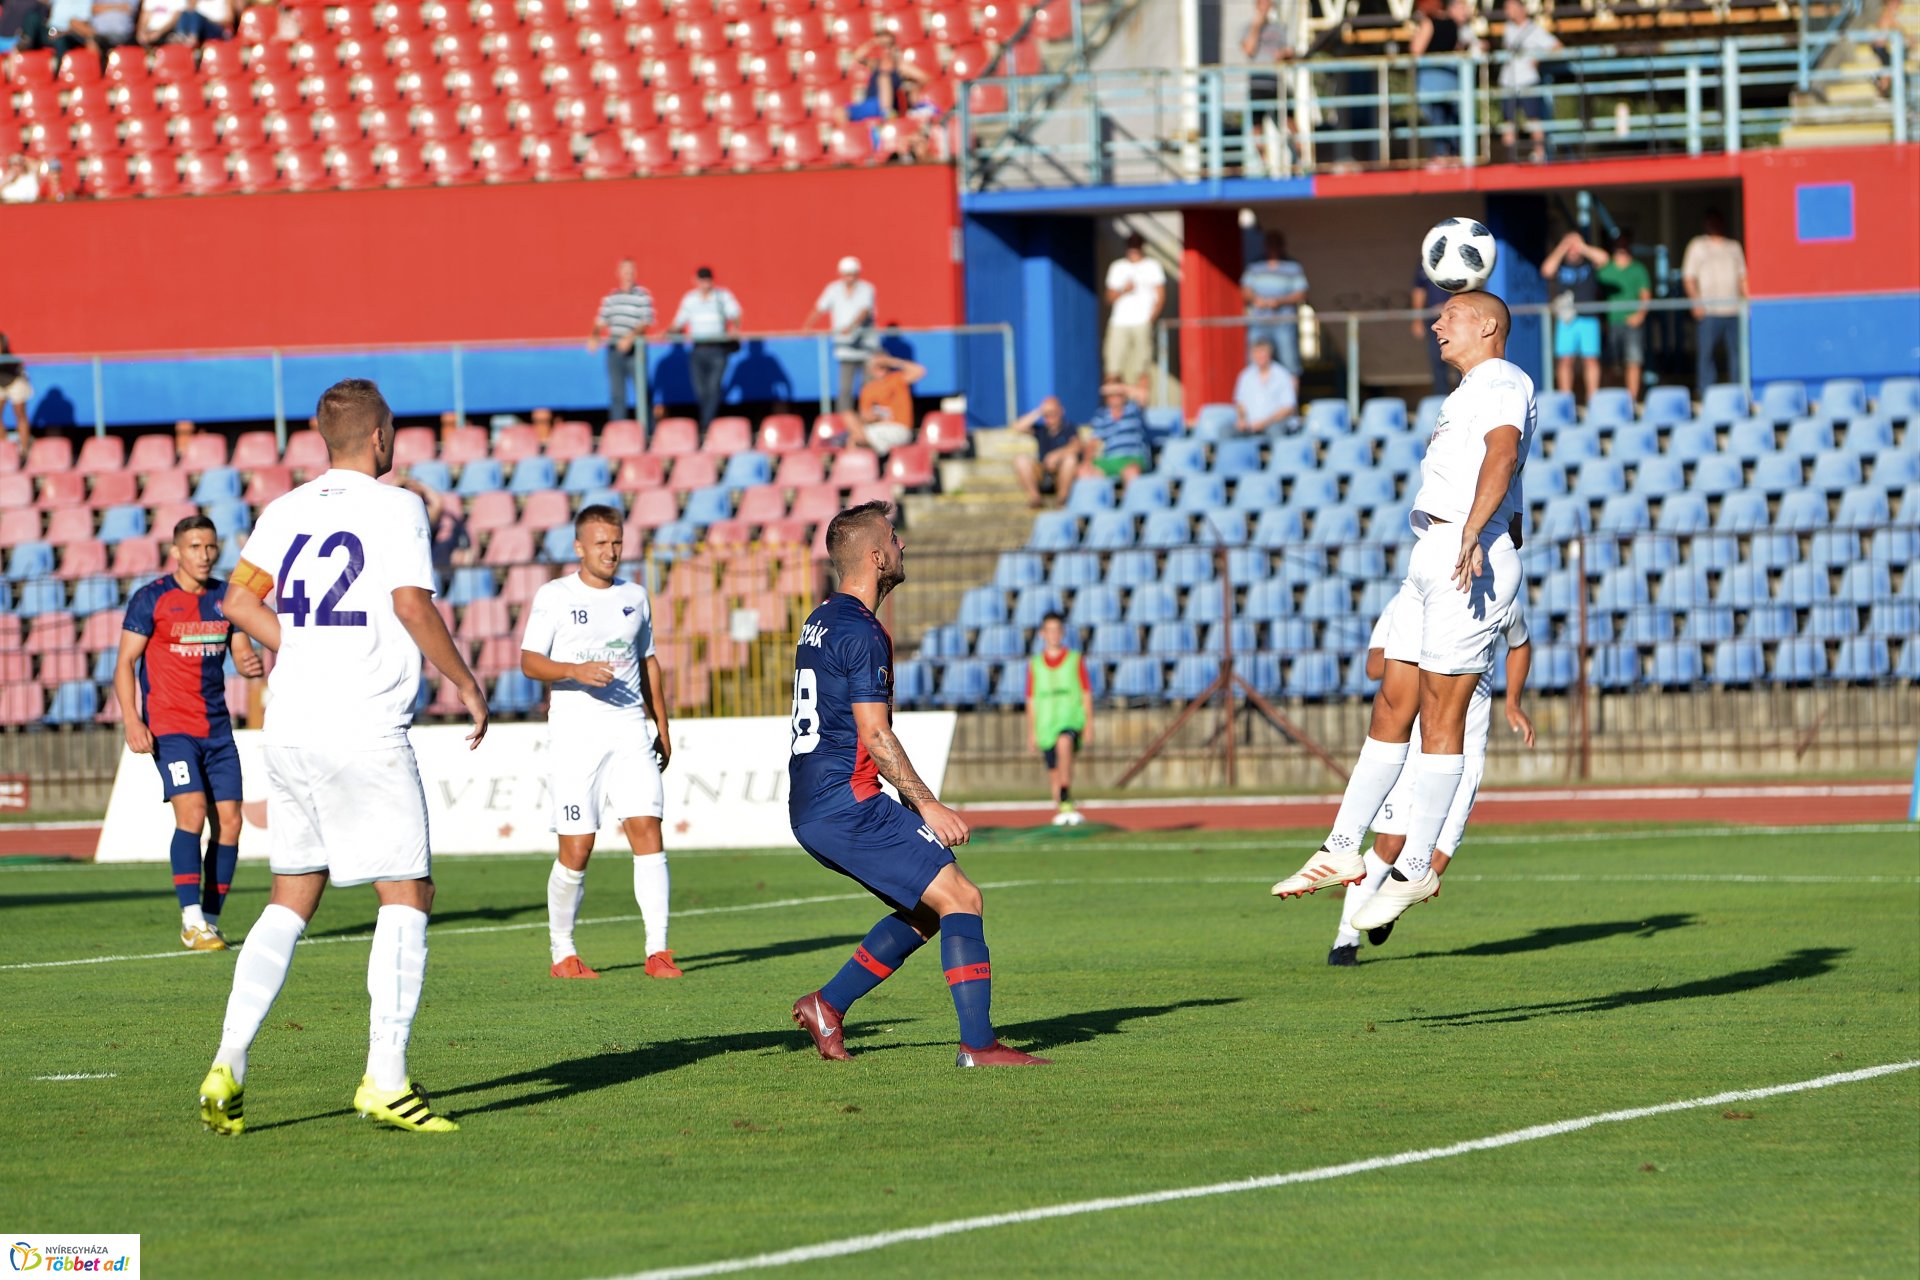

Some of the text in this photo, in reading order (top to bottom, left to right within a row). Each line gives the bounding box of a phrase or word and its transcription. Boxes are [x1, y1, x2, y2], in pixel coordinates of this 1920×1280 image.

[275, 531, 367, 627] 42
[570, 609, 588, 625] 18
[791, 668, 821, 756] 8
[167, 760, 191, 787] 18
[563, 805, 581, 821] 18
[1384, 803, 1393, 820] 5
[916, 823, 945, 850] 4
